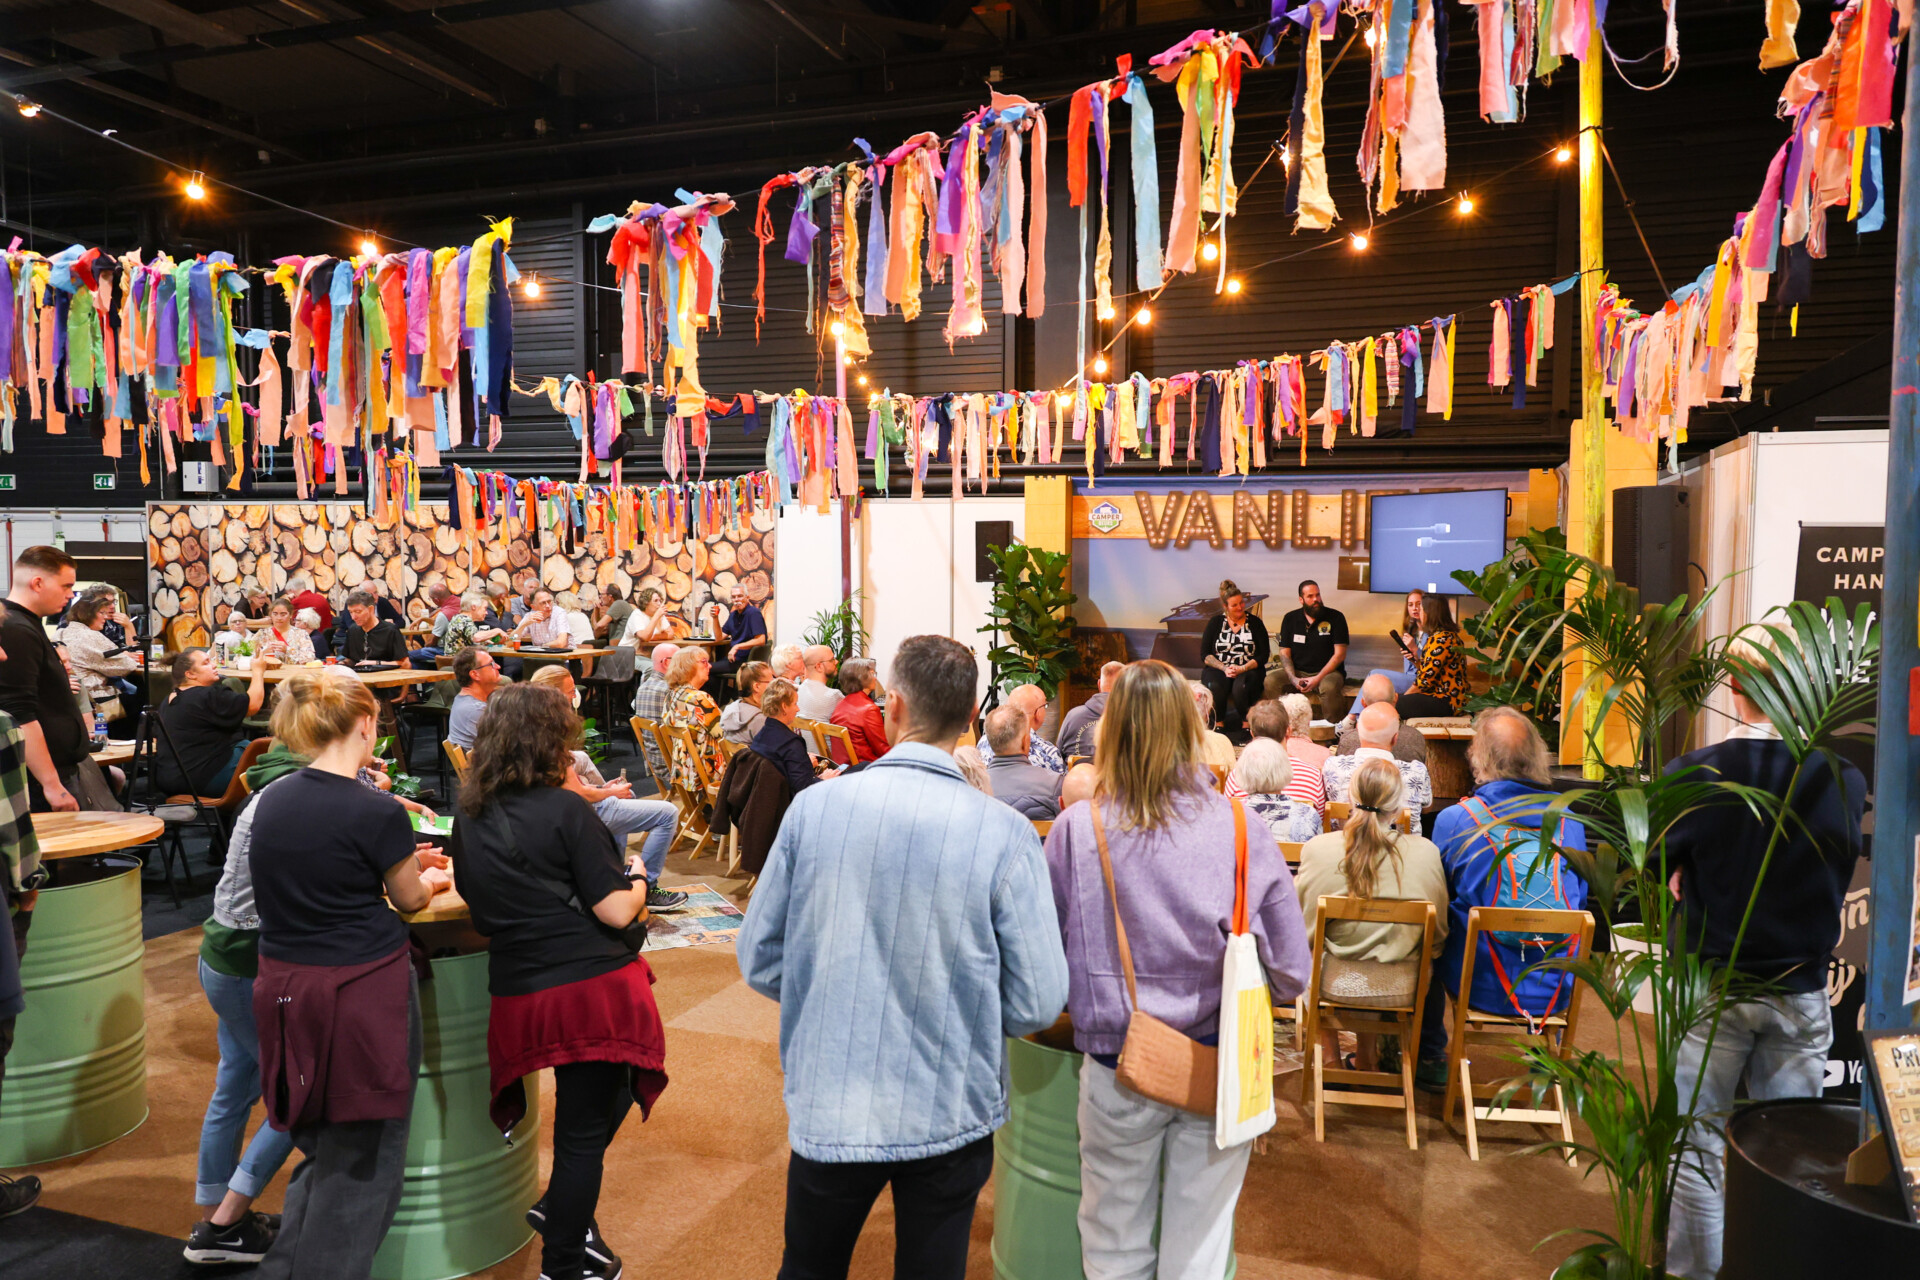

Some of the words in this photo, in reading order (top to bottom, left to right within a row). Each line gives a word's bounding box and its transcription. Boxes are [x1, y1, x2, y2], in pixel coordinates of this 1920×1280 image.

[1134, 488, 1463, 550] VANLI
[1816, 546, 1885, 563] CAMP
[1834, 574, 1884, 590] HAN
